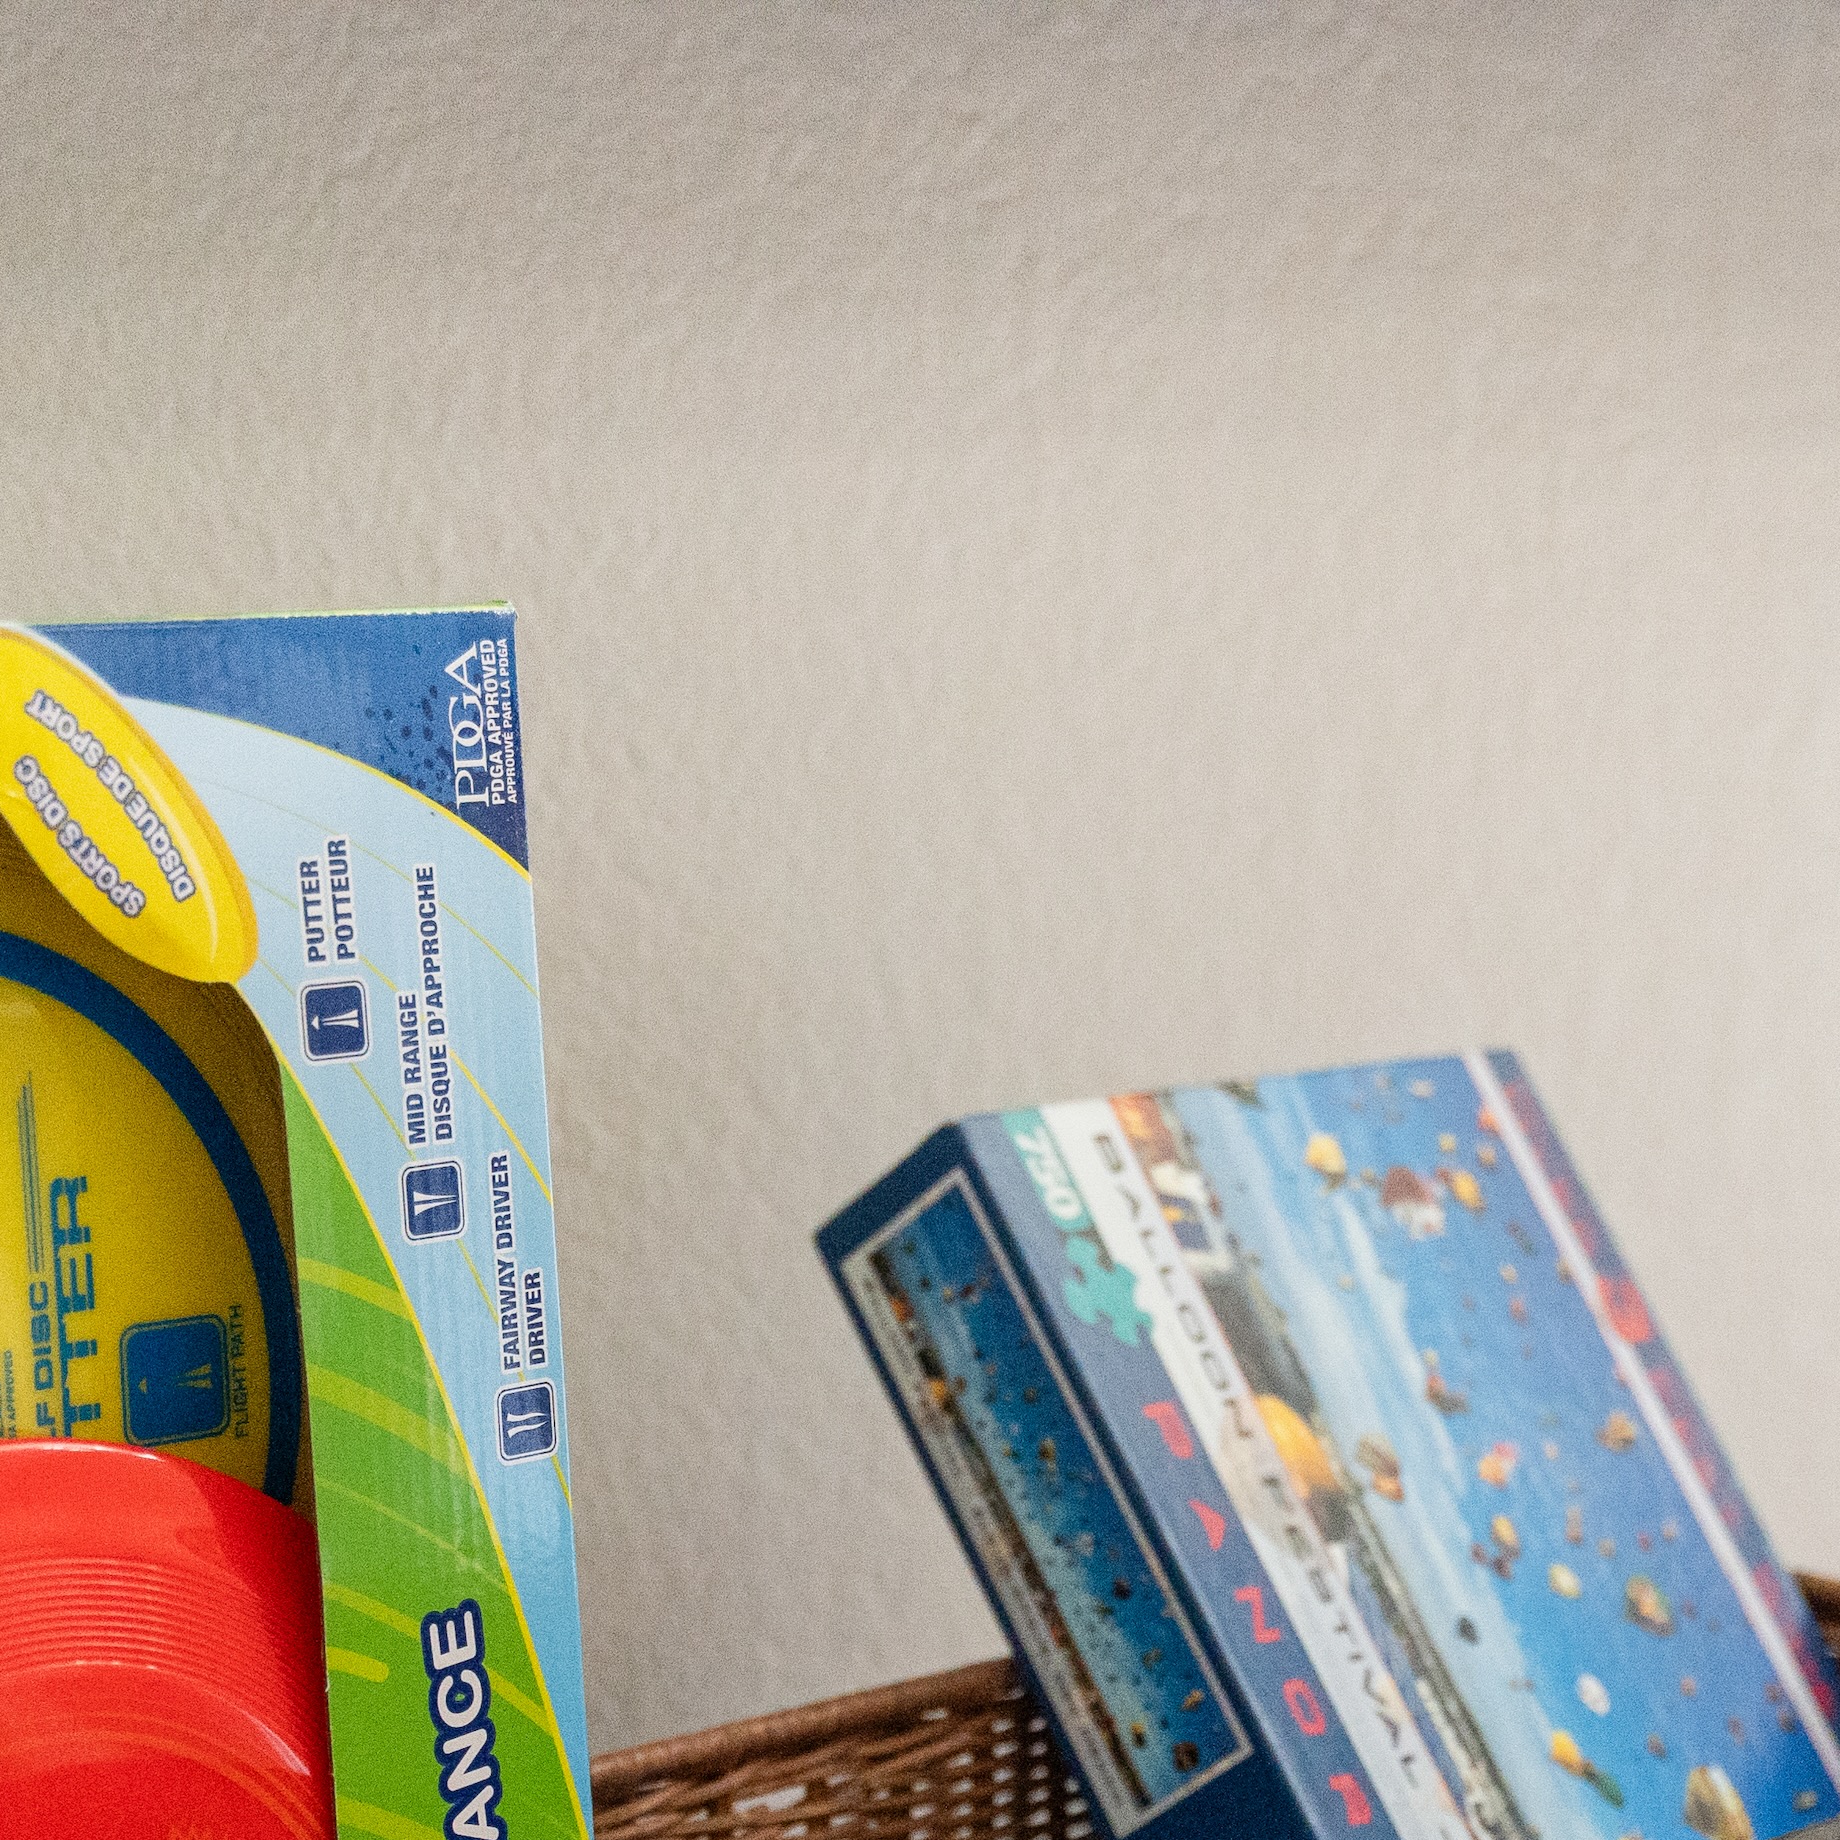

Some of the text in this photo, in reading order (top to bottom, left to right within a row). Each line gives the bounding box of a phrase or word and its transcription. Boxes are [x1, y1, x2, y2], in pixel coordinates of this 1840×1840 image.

[24, 689, 196, 902] DISQUE DE SPORT
[444, 641, 490, 809] PDGA
[479, 639, 505, 804] PDGA APPROVED
[497, 638, 517, 803] APPROUVÉ PAR LA PDGA
[13, 754, 146, 918] SPORTS DISC
[299, 861, 326, 962] PUTTER
[327, 840, 355, 960] POTTEUR
[398, 994, 427, 1144] MID RANGE
[416, 867, 452, 1140] DISQUE D'APPROCHE
[1011, 1124, 1086, 1219] 750
[29, 1282, 54, 1391] DISC
[50, 1177, 101, 1438] TTER
[491, 1155, 520, 1370] FAIRWAY DRIVER
[524, 1272, 546, 1365] DRIVER
[228, 1304, 249, 1439] FLIGHT PATH
[1090, 1129, 1255, 1440] BALLOON
[1257, 1474, 1426, 1790] FESTIVAL
